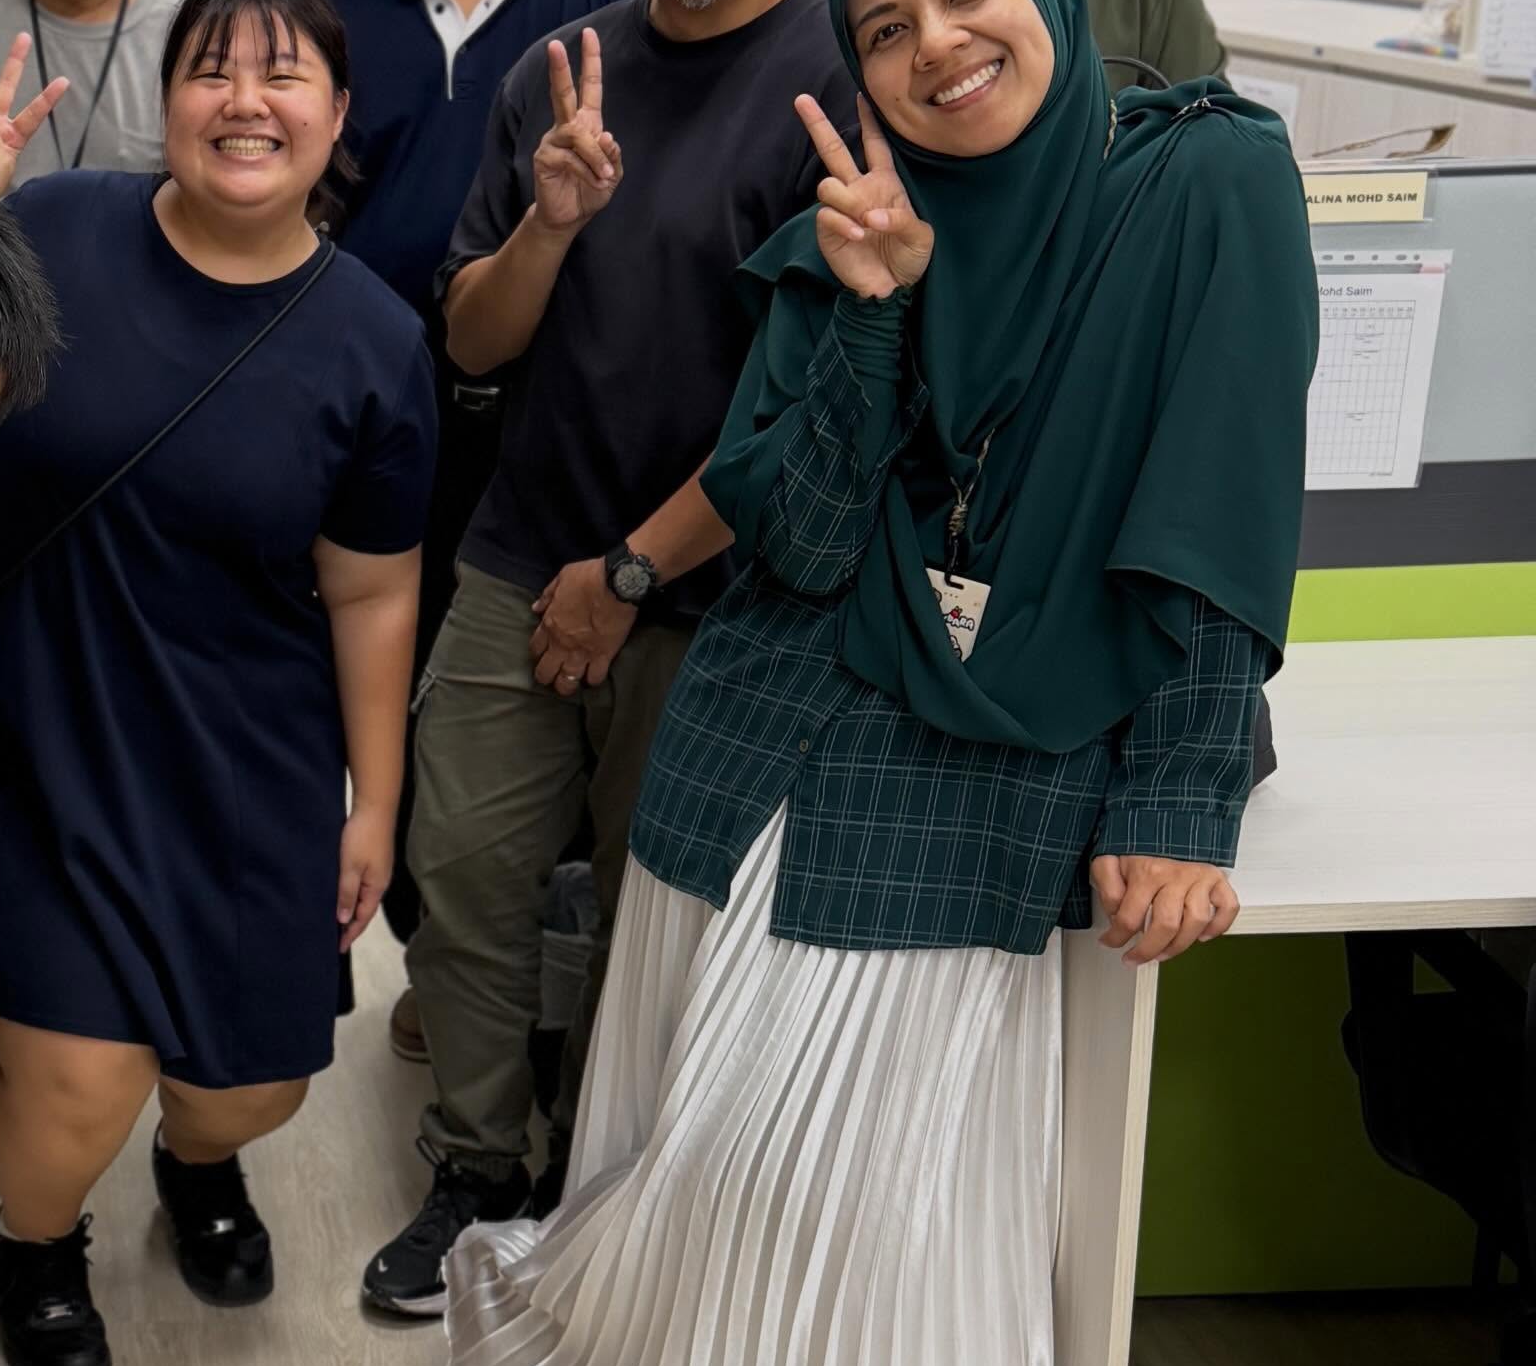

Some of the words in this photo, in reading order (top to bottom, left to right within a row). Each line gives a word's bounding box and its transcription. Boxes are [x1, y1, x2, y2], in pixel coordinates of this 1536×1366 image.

[1346, 194, 1384, 204] MOHD
[1386, 193, 1418, 202] SAIM
[1319, 286, 1343, 296] ohd
[1345, 286, 1373, 296] Saim
